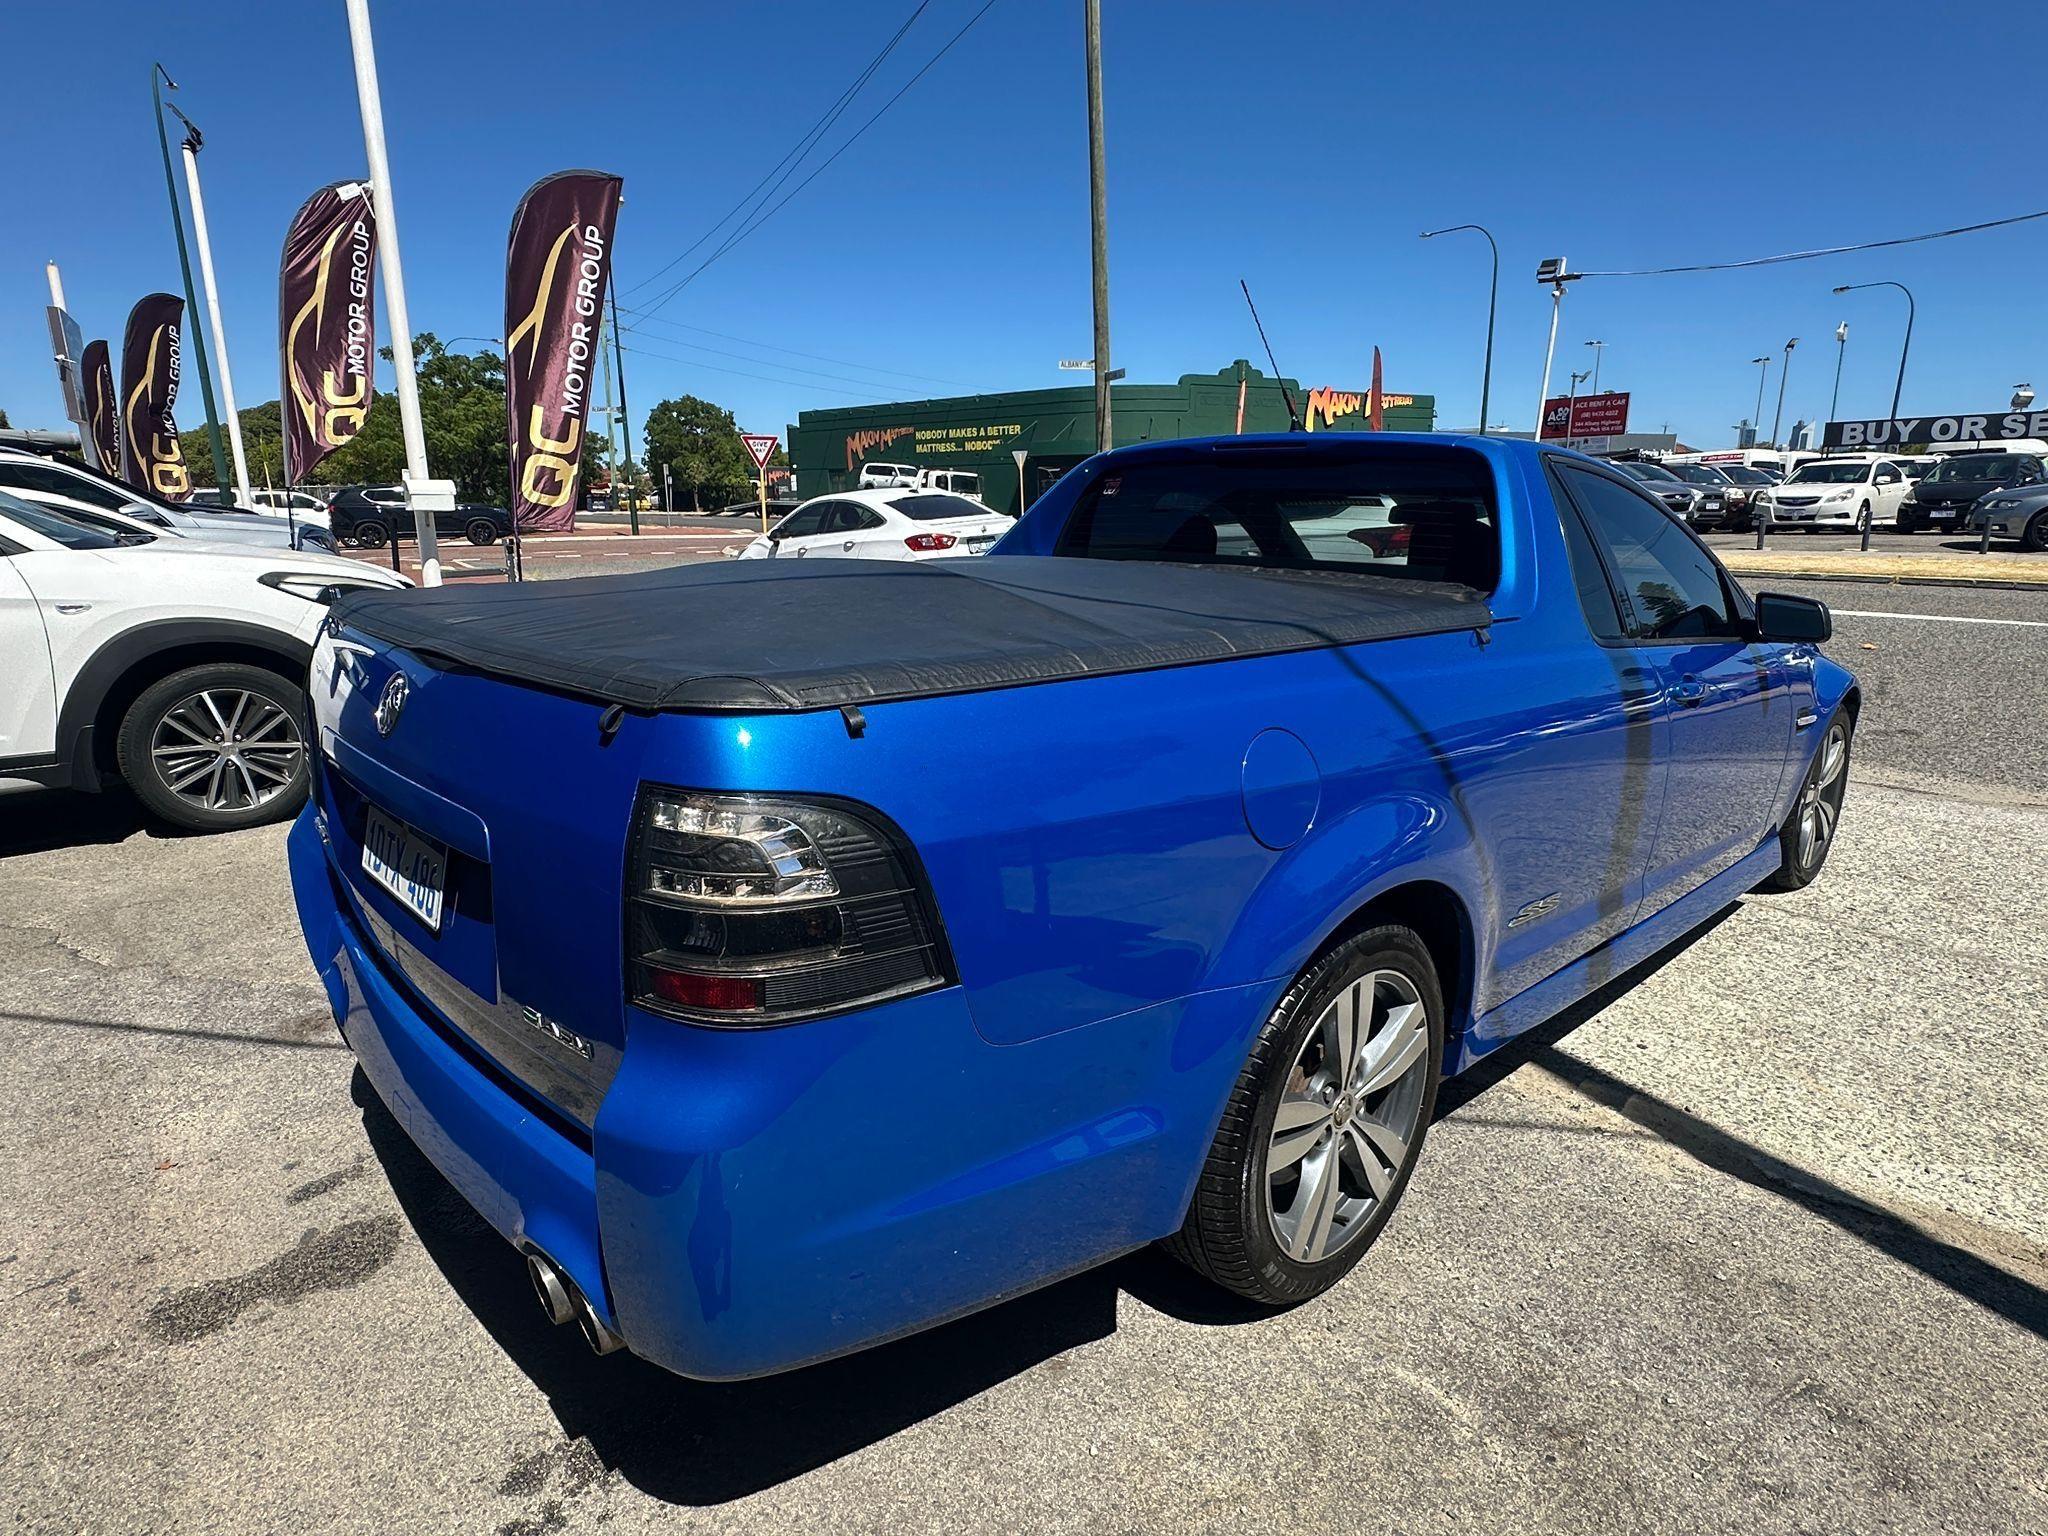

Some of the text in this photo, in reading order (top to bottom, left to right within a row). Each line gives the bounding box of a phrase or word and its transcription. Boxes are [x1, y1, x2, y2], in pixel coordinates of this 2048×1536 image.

[347, 220, 371, 375] MOTOR GROUP
[561, 224, 605, 415] MOTOR GROUP
[162, 324, 181, 438] MOTOR GROUP
[1060, 360, 1083, 368] ALBANY
[324, 370, 368, 446] QC
[916, 425, 1021, 440] NOBODY MAKES A BETTER
[1305, 386, 1361, 433] MAKIN
[1841, 413, 2048, 445] BUY OR SE
[152, 433, 189, 494] QC
[521, 404, 580, 508] QC
